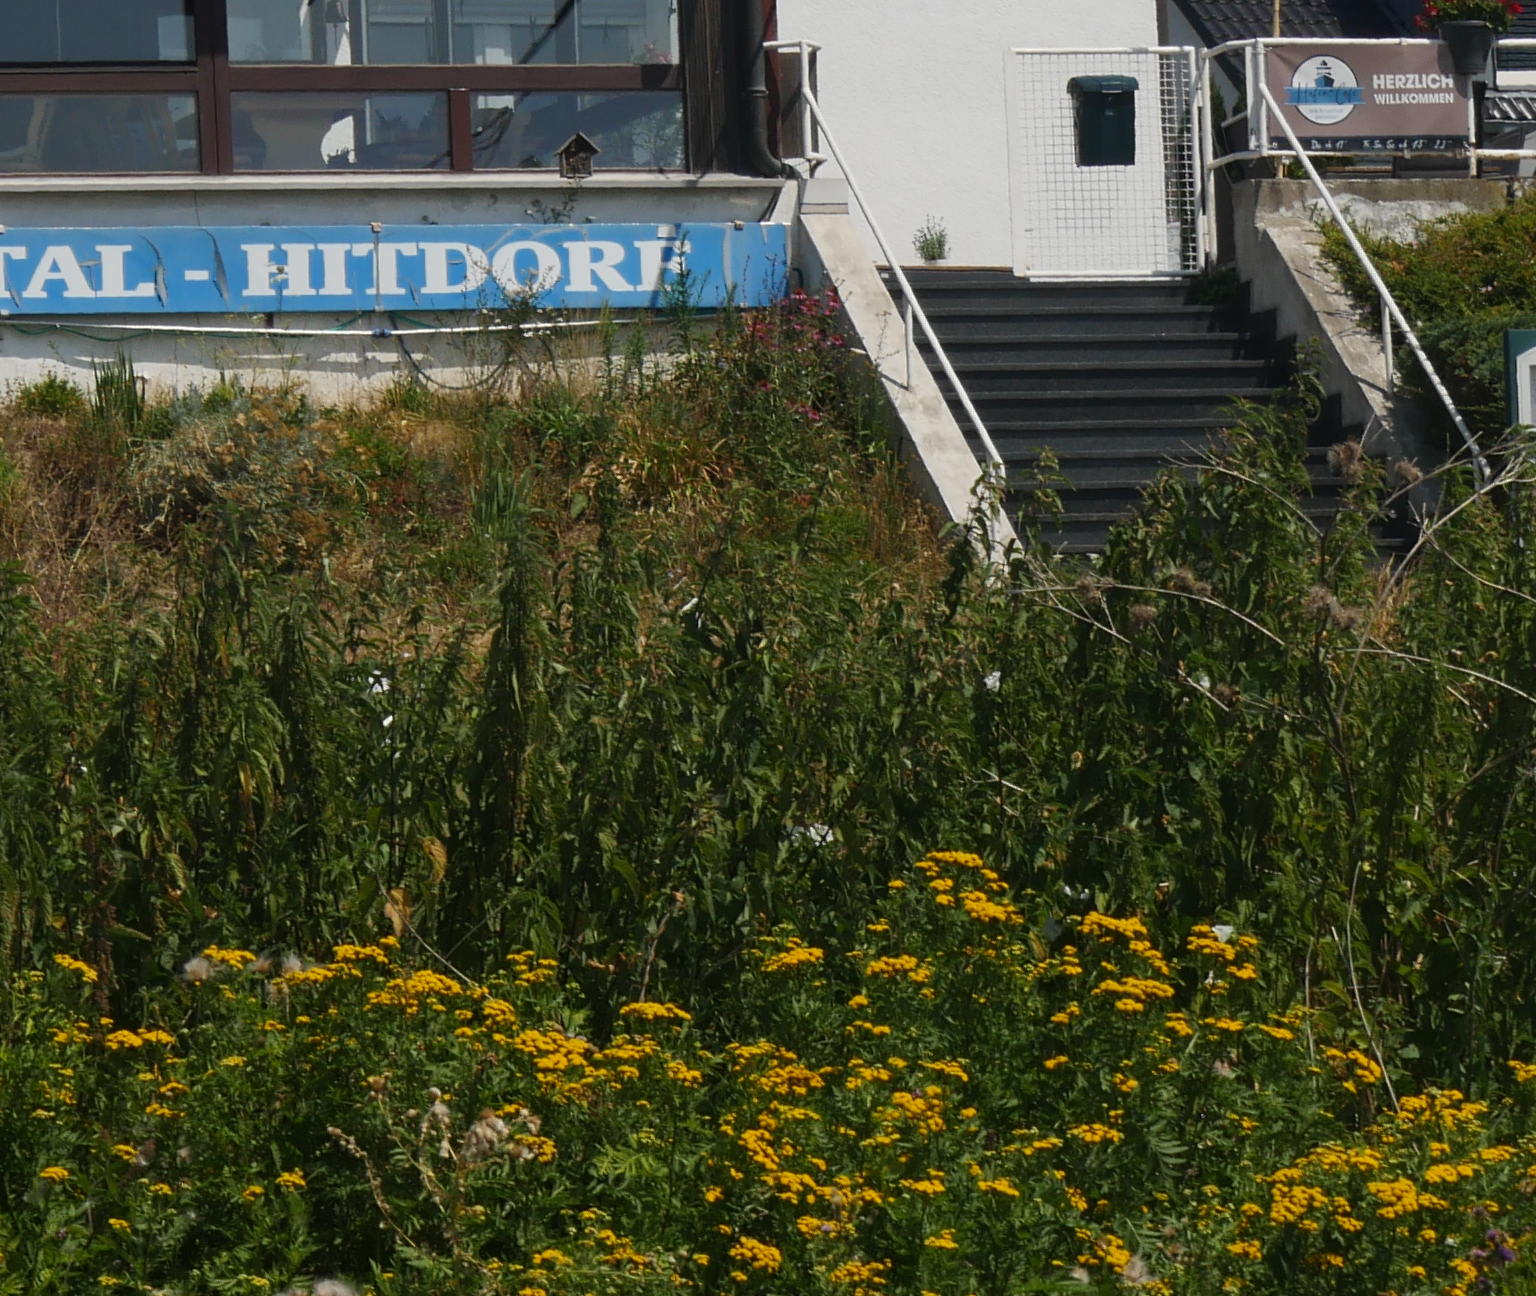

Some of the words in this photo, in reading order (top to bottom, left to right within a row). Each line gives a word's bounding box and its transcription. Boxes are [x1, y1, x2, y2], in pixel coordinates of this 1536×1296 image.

[1372, 74, 1454, 89] HERZLICH
[1373, 92, 1454, 105] WILLKOMMEN
[240, 239, 691, 297] HITDORF
